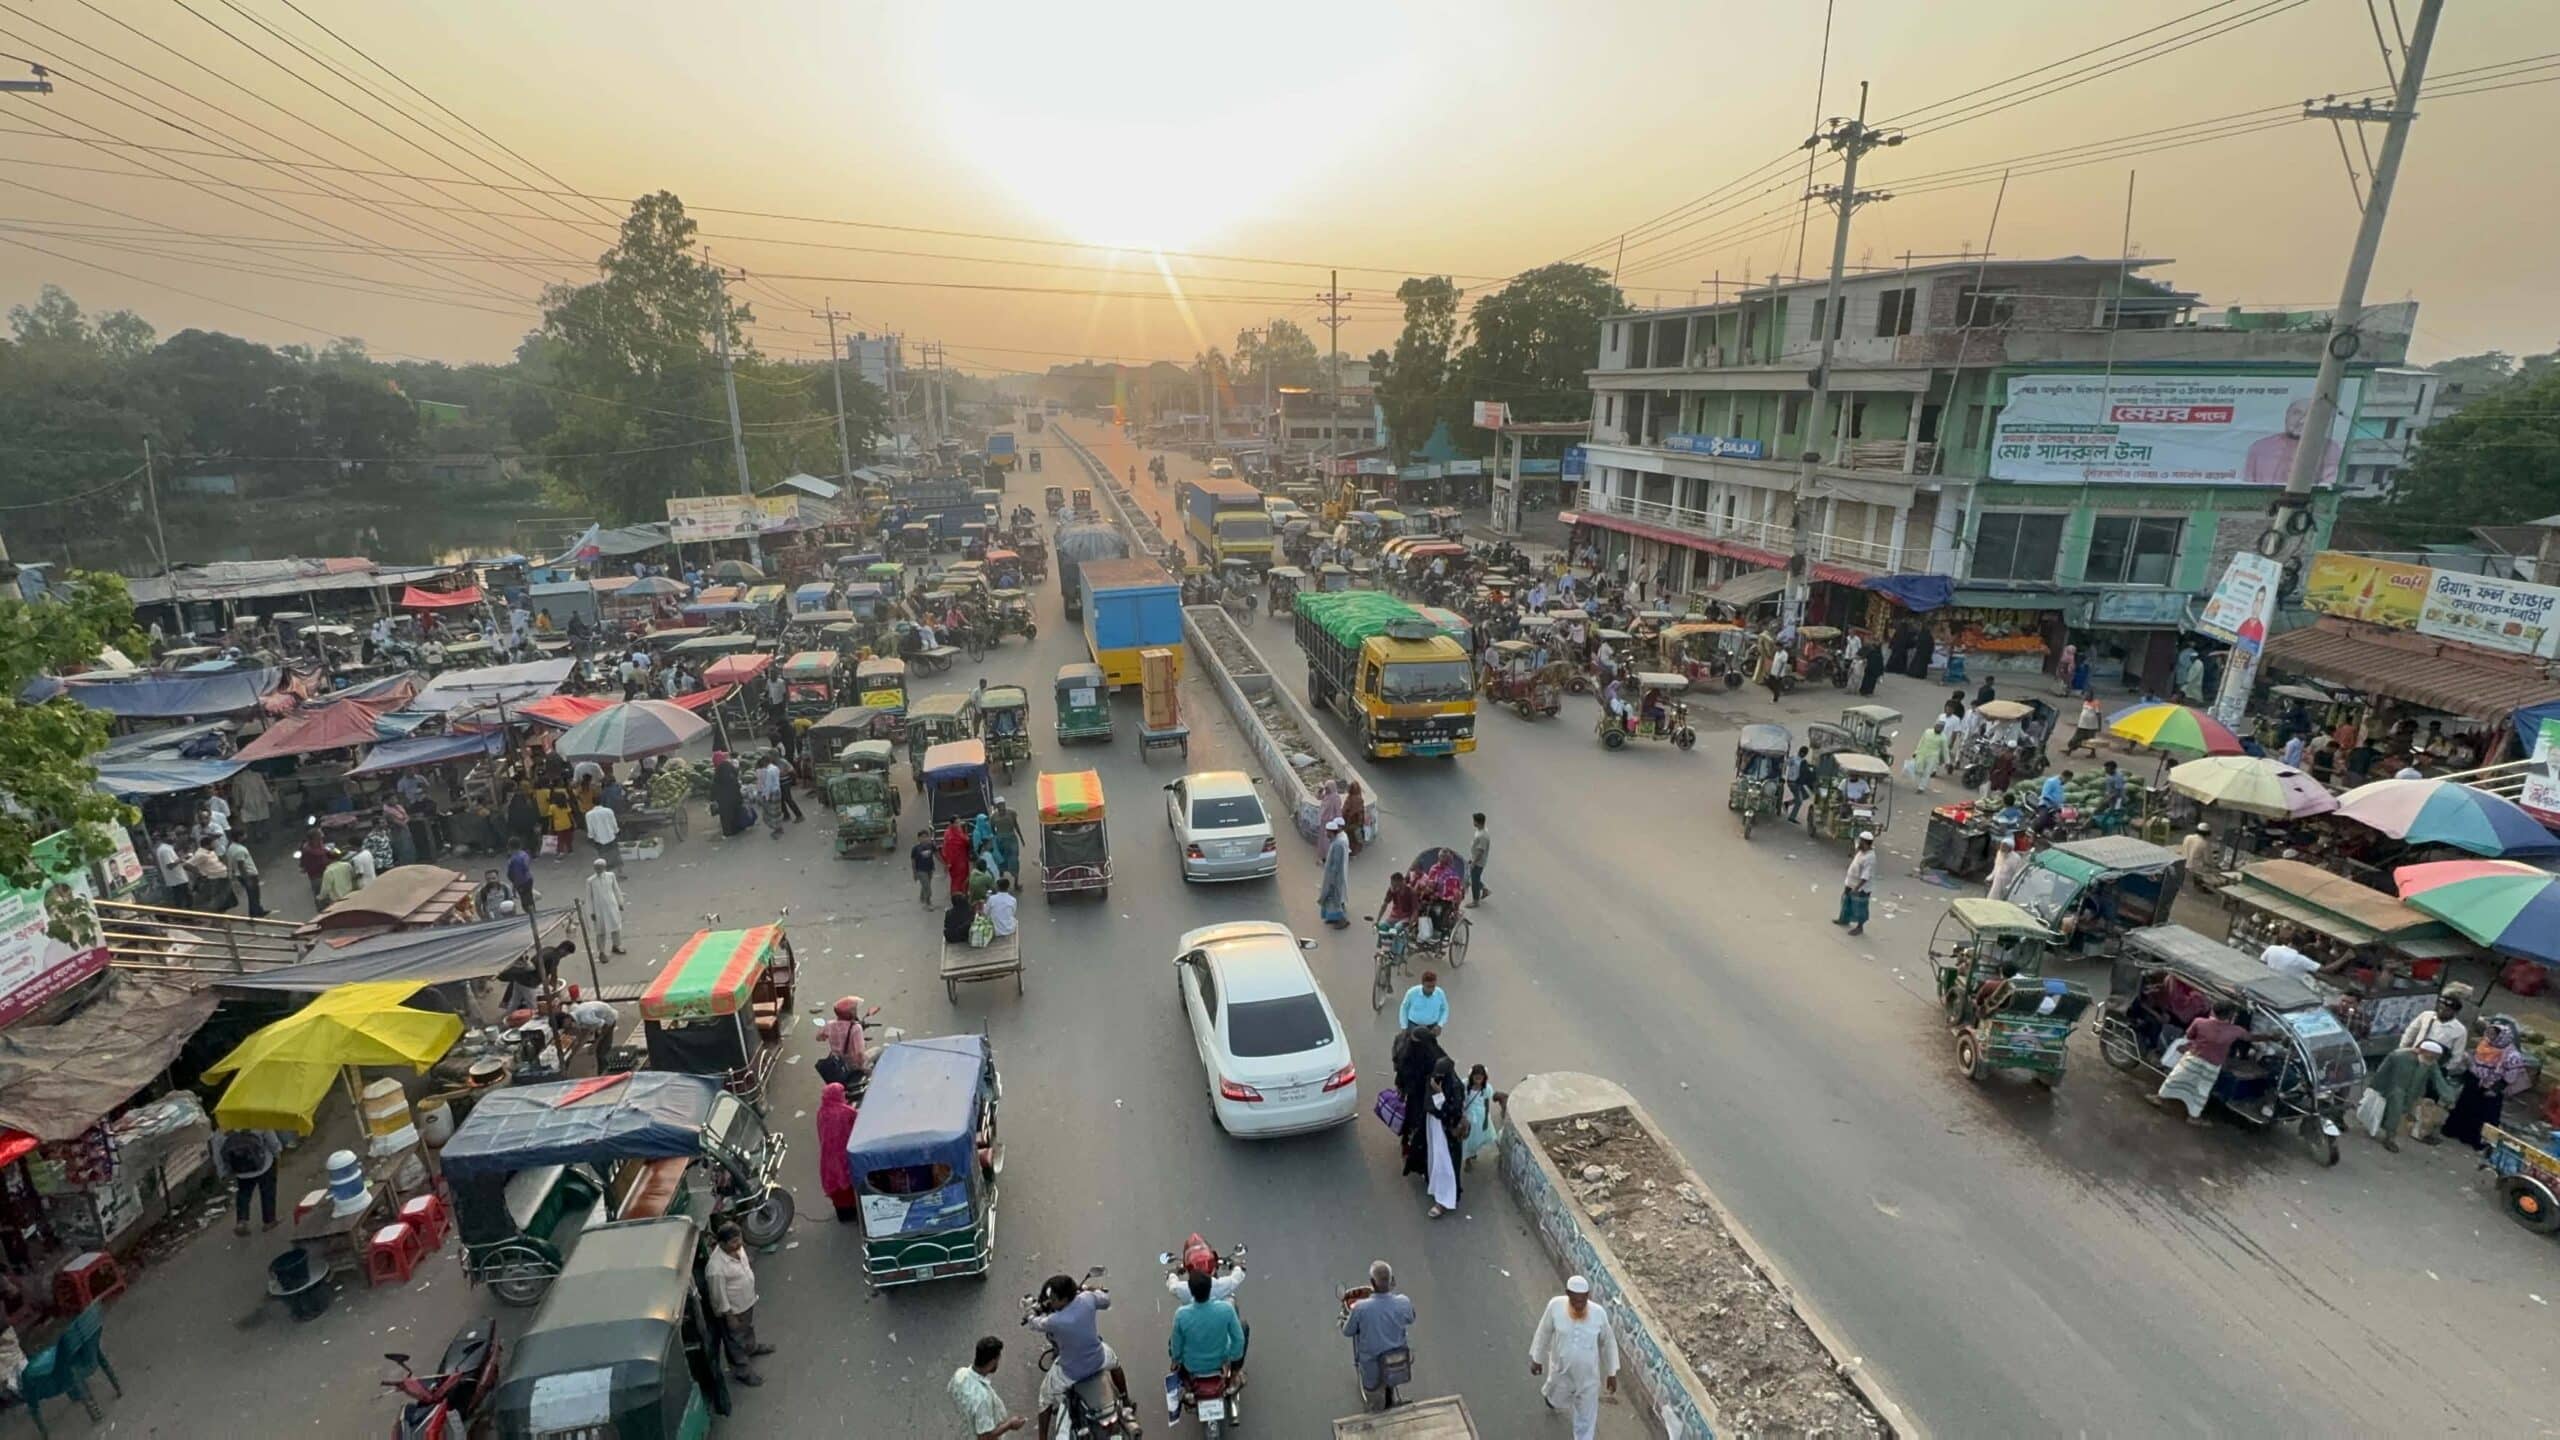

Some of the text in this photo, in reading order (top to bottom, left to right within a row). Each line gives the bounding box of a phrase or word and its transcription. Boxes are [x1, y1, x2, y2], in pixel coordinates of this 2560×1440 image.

[2115, 406, 2226, 422] মেয়র পদে
[1723, 442, 1756, 454] BAJAJ
[1997, 443, 2032, 460] মোঃ
[2036, 444, 2109, 461] সাদরুল
[2390, 575, 2424, 589] aafi
[2436, 575, 2472, 598] রিয়াদ
[2477, 585, 2505, 603] ফল
